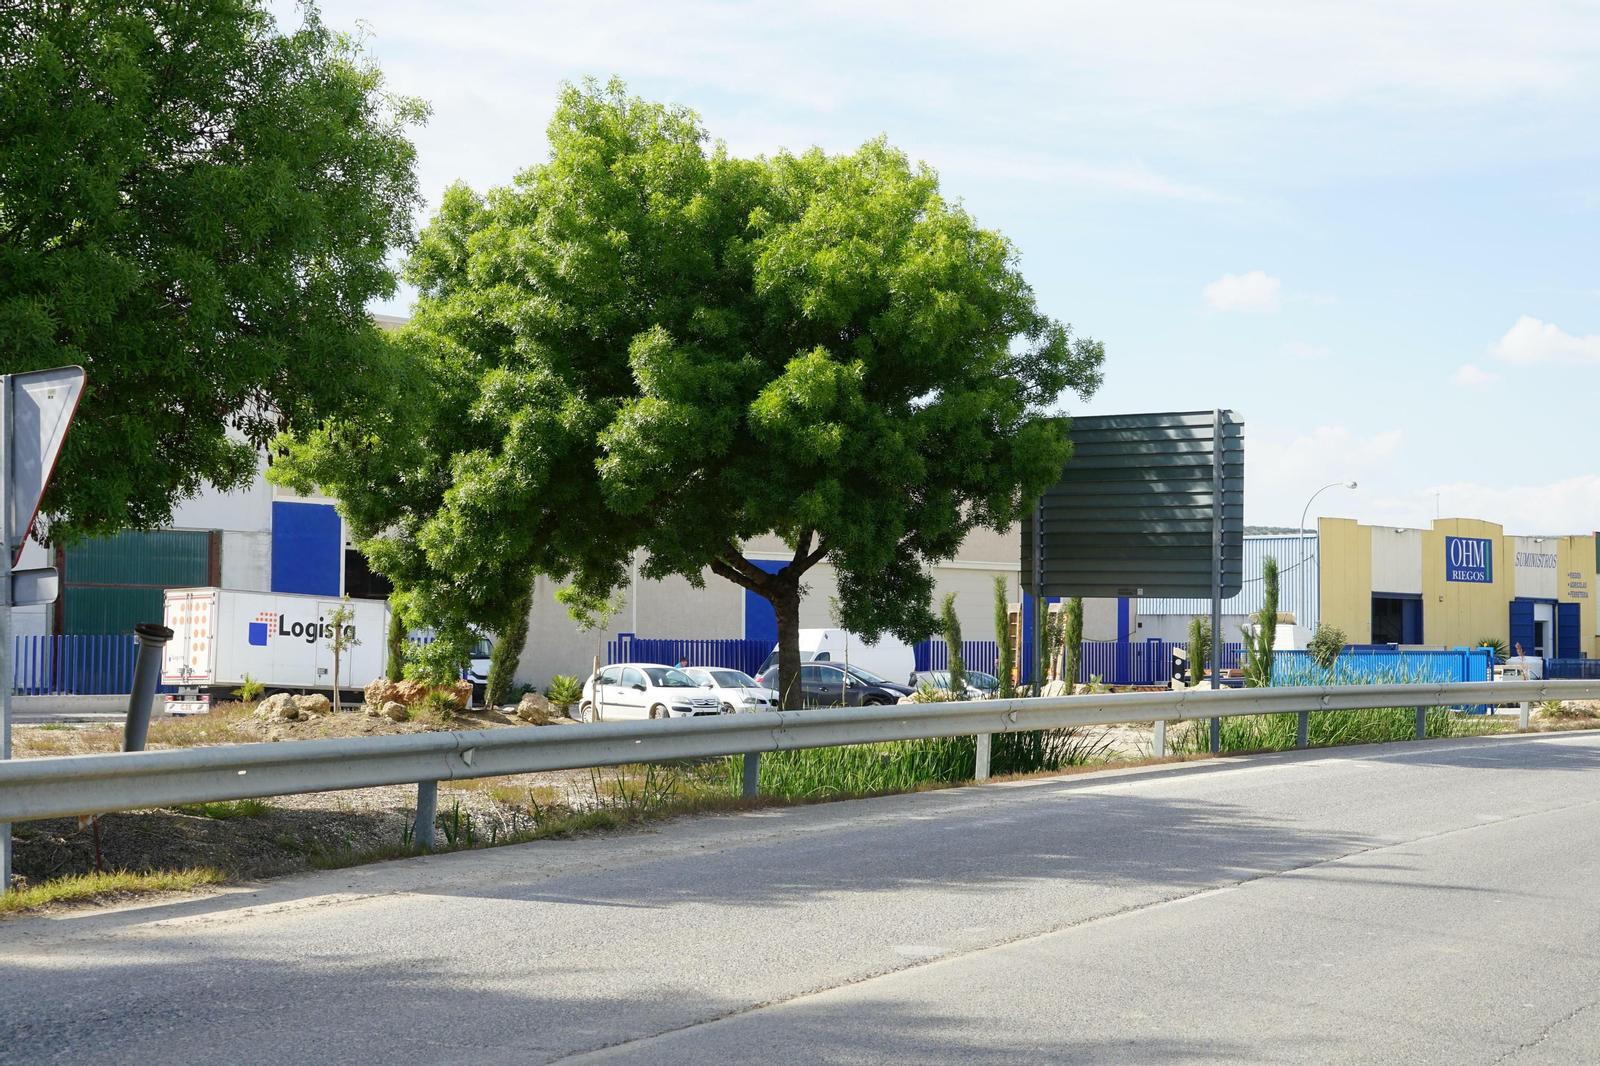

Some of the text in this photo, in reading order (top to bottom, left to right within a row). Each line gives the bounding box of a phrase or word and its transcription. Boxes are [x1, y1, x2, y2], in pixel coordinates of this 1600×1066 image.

[1450, 538, 1485, 568] OHM
[1515, 551, 1558, 569] SUMINISTROS
[1452, 570, 1485, 581] RIEGOS
